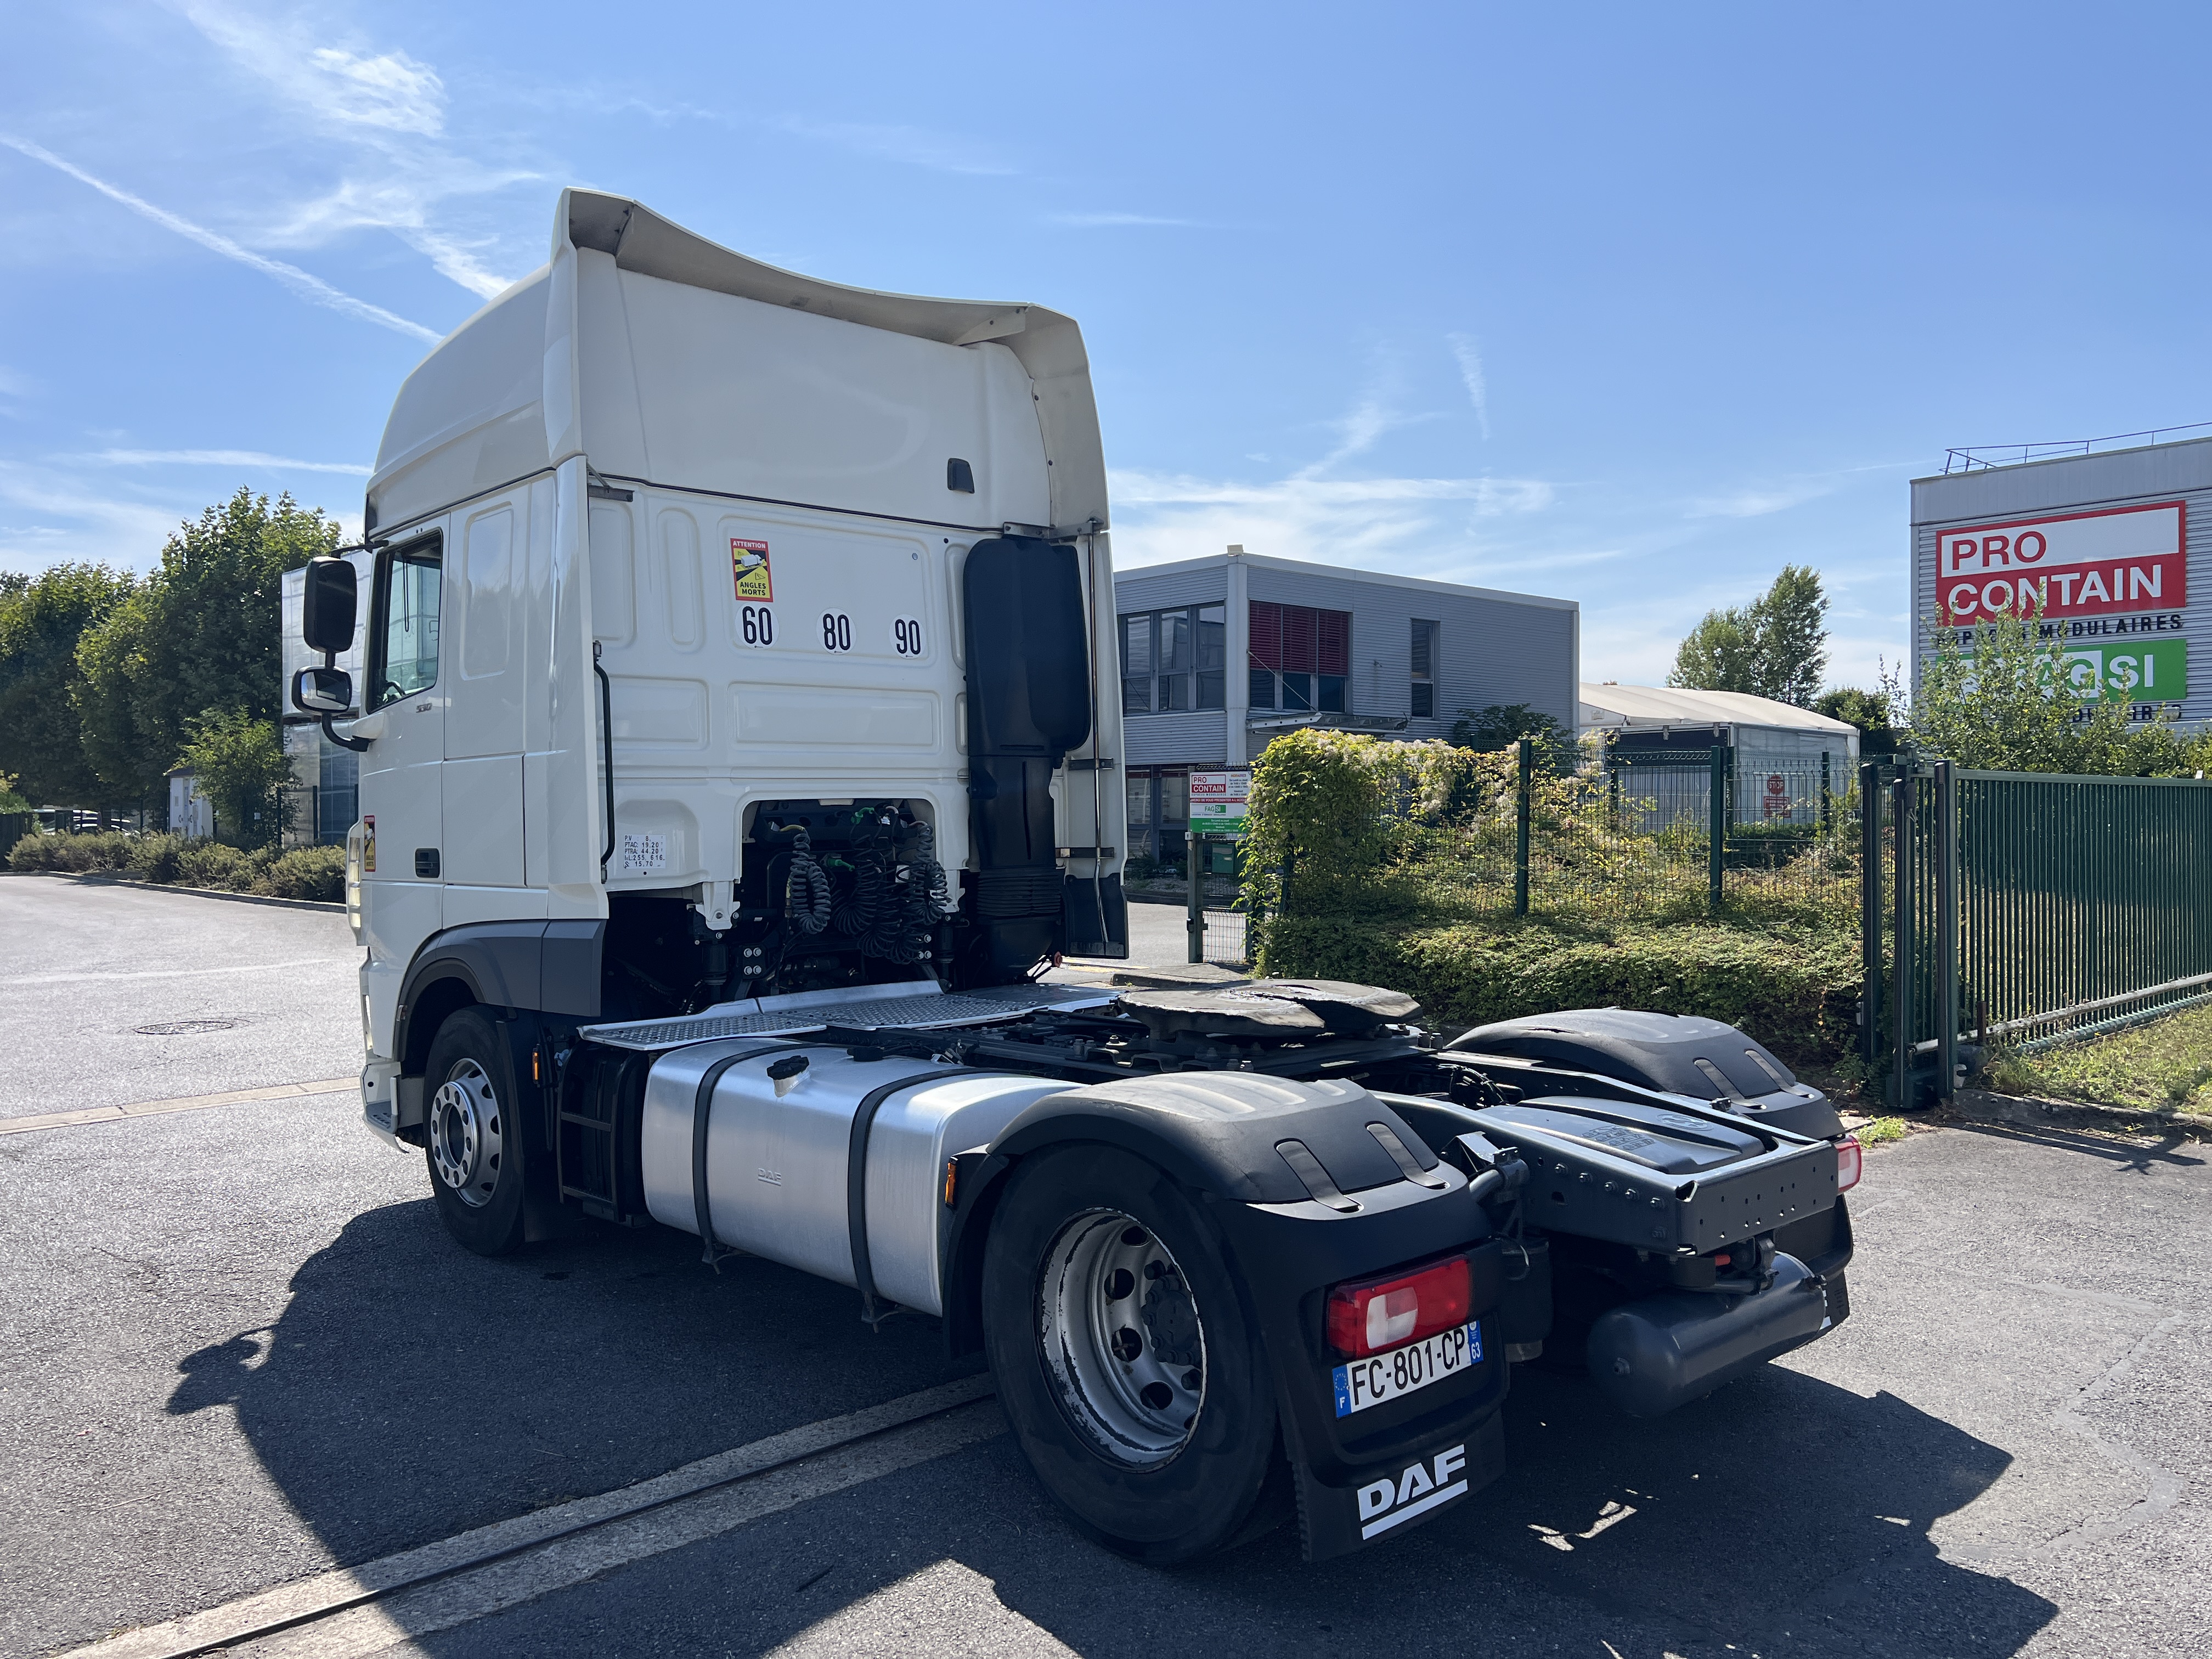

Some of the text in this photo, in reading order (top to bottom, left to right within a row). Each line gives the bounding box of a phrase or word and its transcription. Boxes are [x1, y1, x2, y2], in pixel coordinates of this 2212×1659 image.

[732, 540, 766, 549] ATTENTION
[1951, 531, 2046, 571] PRO
[1948, 564, 2162, 616] CONTAIN
[742, 606, 773, 645] 60
[823, 613, 851, 651] 80
[895, 618, 921, 655] 90
[758, 1167, 782, 1181] DAF
[1351, 1328, 1465, 1406] FC-801-CP
[1471, 1341, 1481, 1359] 63
[1339, 1396, 1345, 1408] F
[1357, 1443, 1466, 1522] DAF
